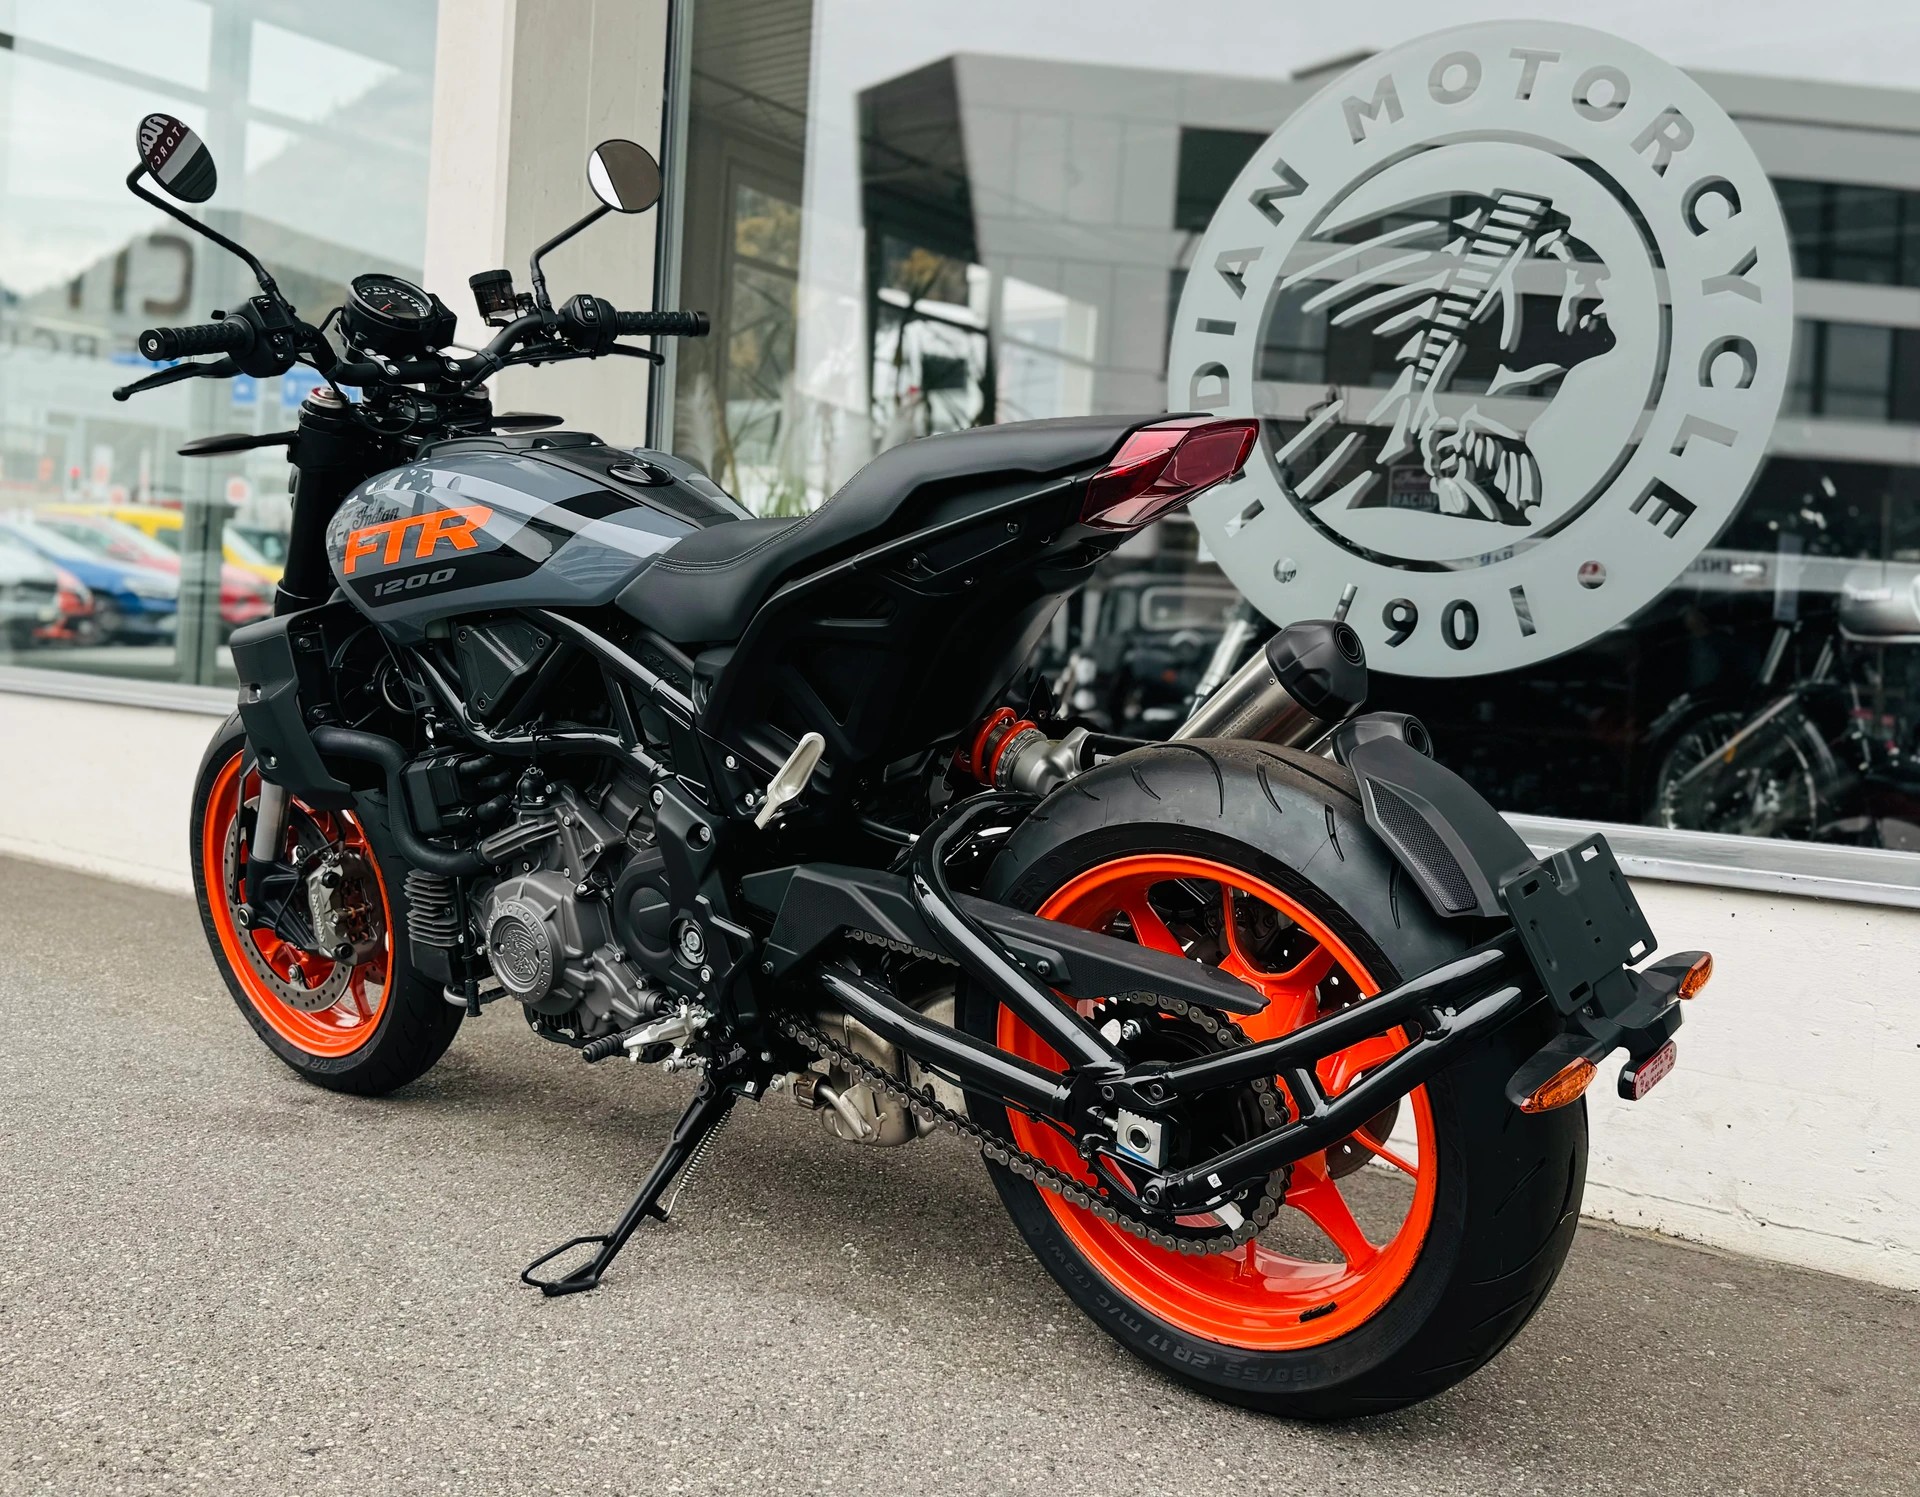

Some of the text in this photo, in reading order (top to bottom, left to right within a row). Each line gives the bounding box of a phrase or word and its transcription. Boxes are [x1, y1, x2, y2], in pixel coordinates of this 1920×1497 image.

[1189, 47, 1762, 539] IDIAN MOTORCYCLE
[343, 504, 494, 575] FTR
[353, 505, 399, 530] Indian
[374, 567, 457, 597] 1200
[1333, 583, 1537, 650] 1901
